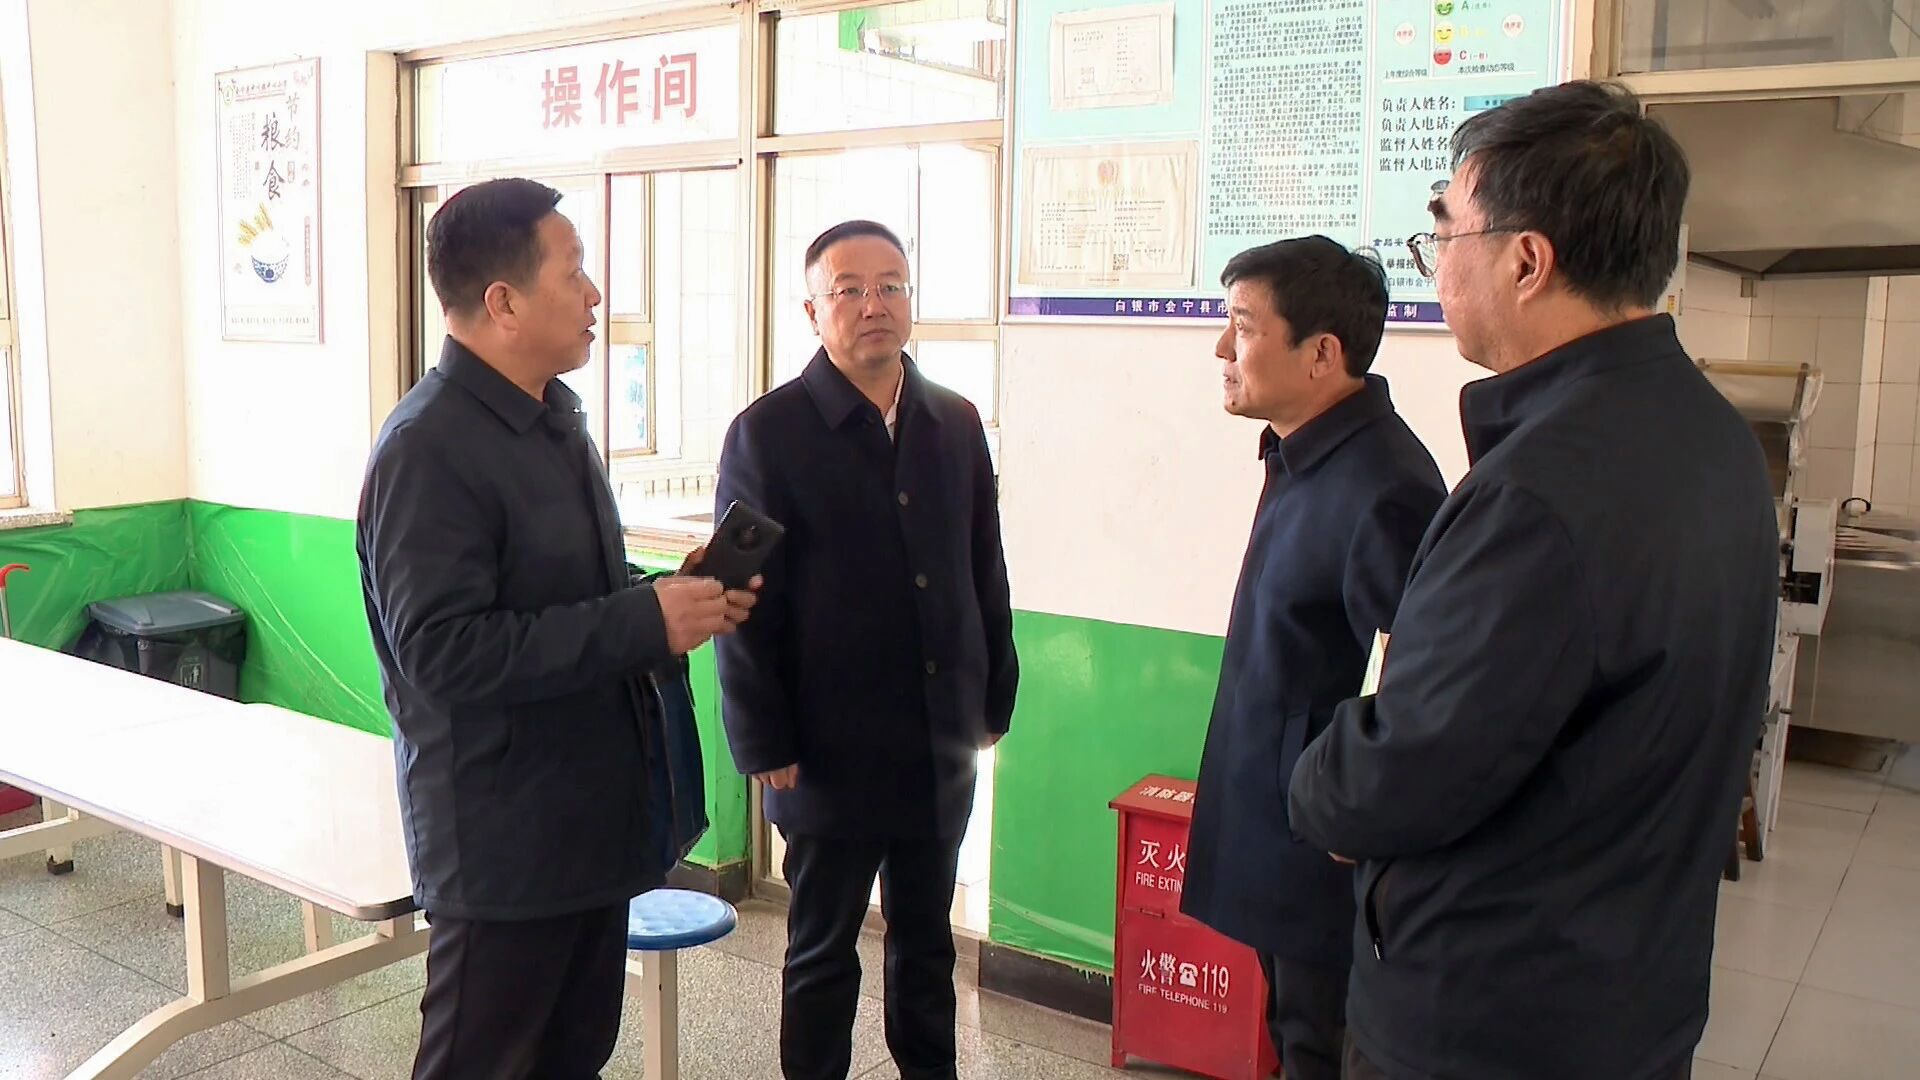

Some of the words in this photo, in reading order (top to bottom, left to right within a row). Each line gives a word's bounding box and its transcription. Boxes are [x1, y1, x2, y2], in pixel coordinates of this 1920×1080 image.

[1461, 0, 1469, 10] A
[1459, 50, 1468, 60] C
[541, 53, 697, 129] 操作间
[285, 94, 301, 151] 节约
[261, 112, 285, 200] 粮食
[1389, 277, 1436, 287] 白银市会宁
[1139, 785, 1194, 803] 消防器
[1137, 840, 1186, 873] 灭火
[1136, 871, 1155, 888] FIRE
[1140, 949, 1176, 986] 火警
[1202, 961, 1229, 998] 119
[1160, 989, 1210, 1010] TELEPHONE
[1213, 1002, 1228, 1014] 119
